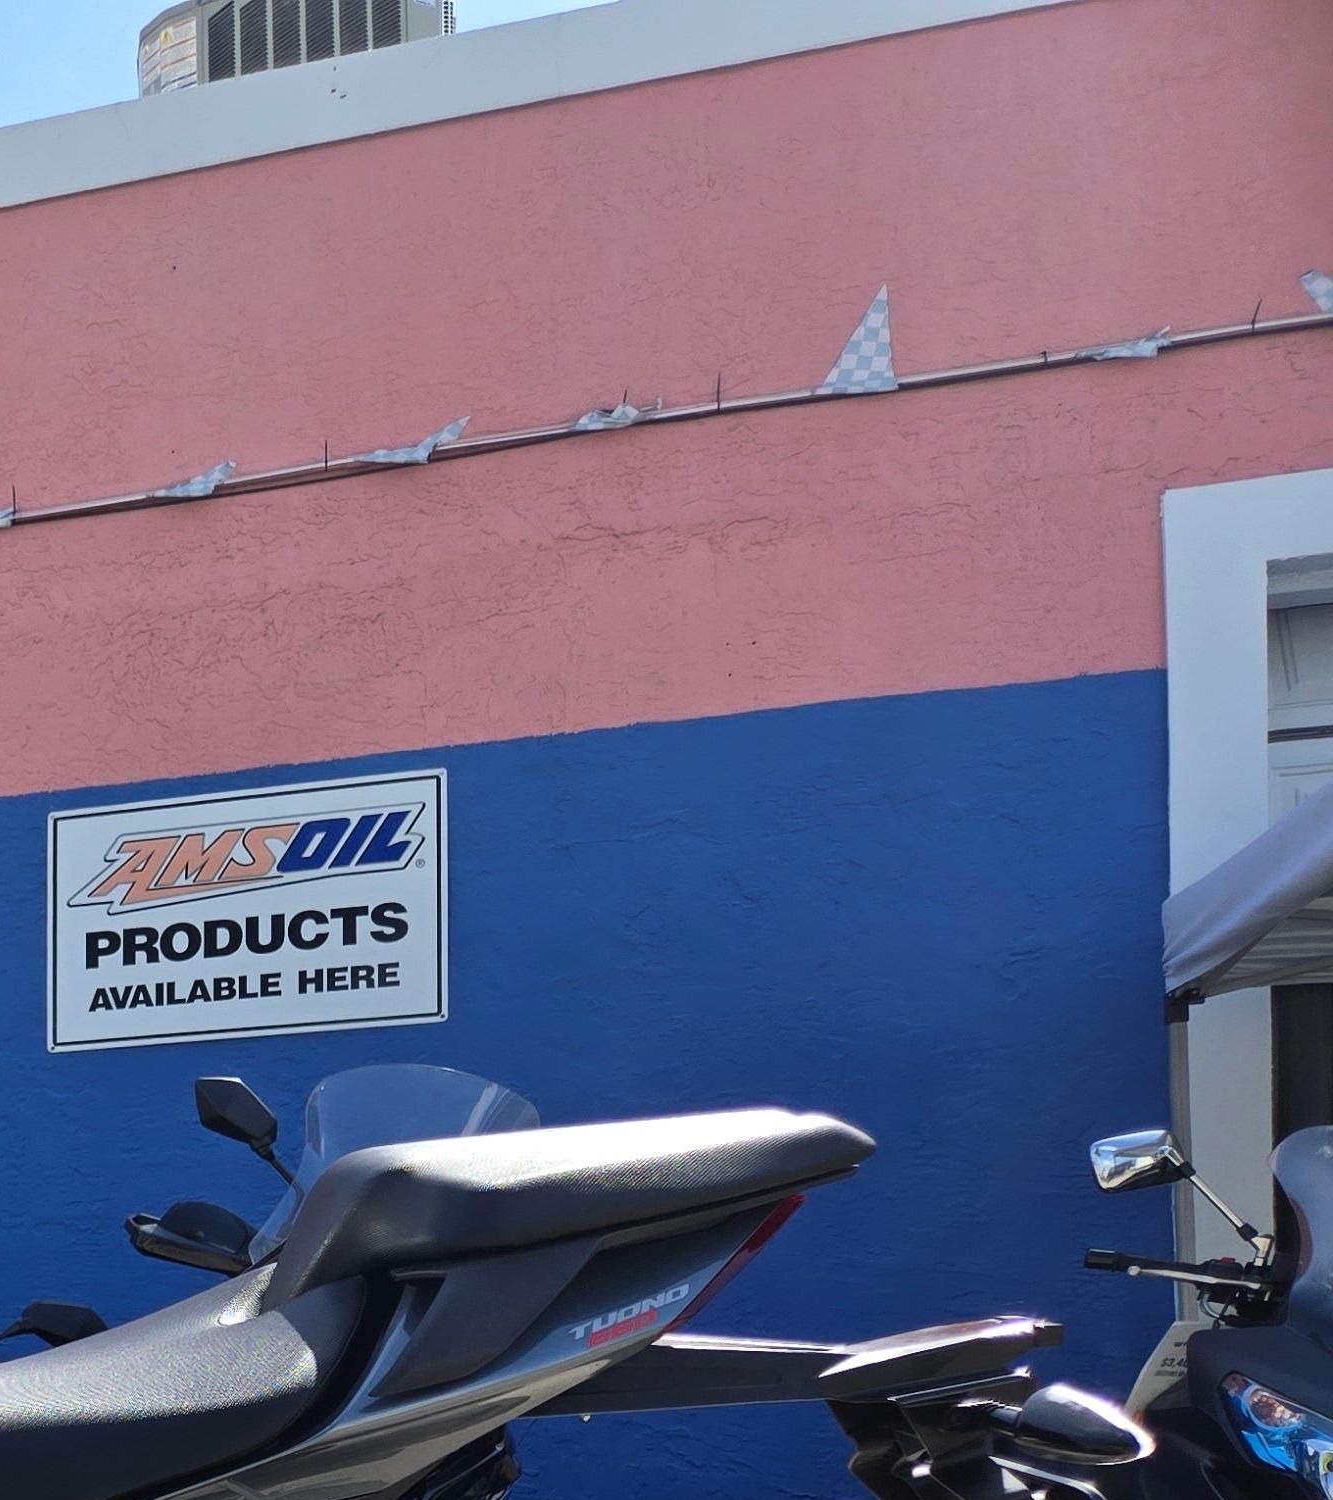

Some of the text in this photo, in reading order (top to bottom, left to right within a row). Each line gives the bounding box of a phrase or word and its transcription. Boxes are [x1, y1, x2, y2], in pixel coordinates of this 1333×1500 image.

[85, 808, 415, 908] AMSOIL
[85, 902, 409, 970] PRODUCTS
[88, 962, 400, 1013] AVAILABLE HERE
[568, 1283, 690, 1340] TUONO
